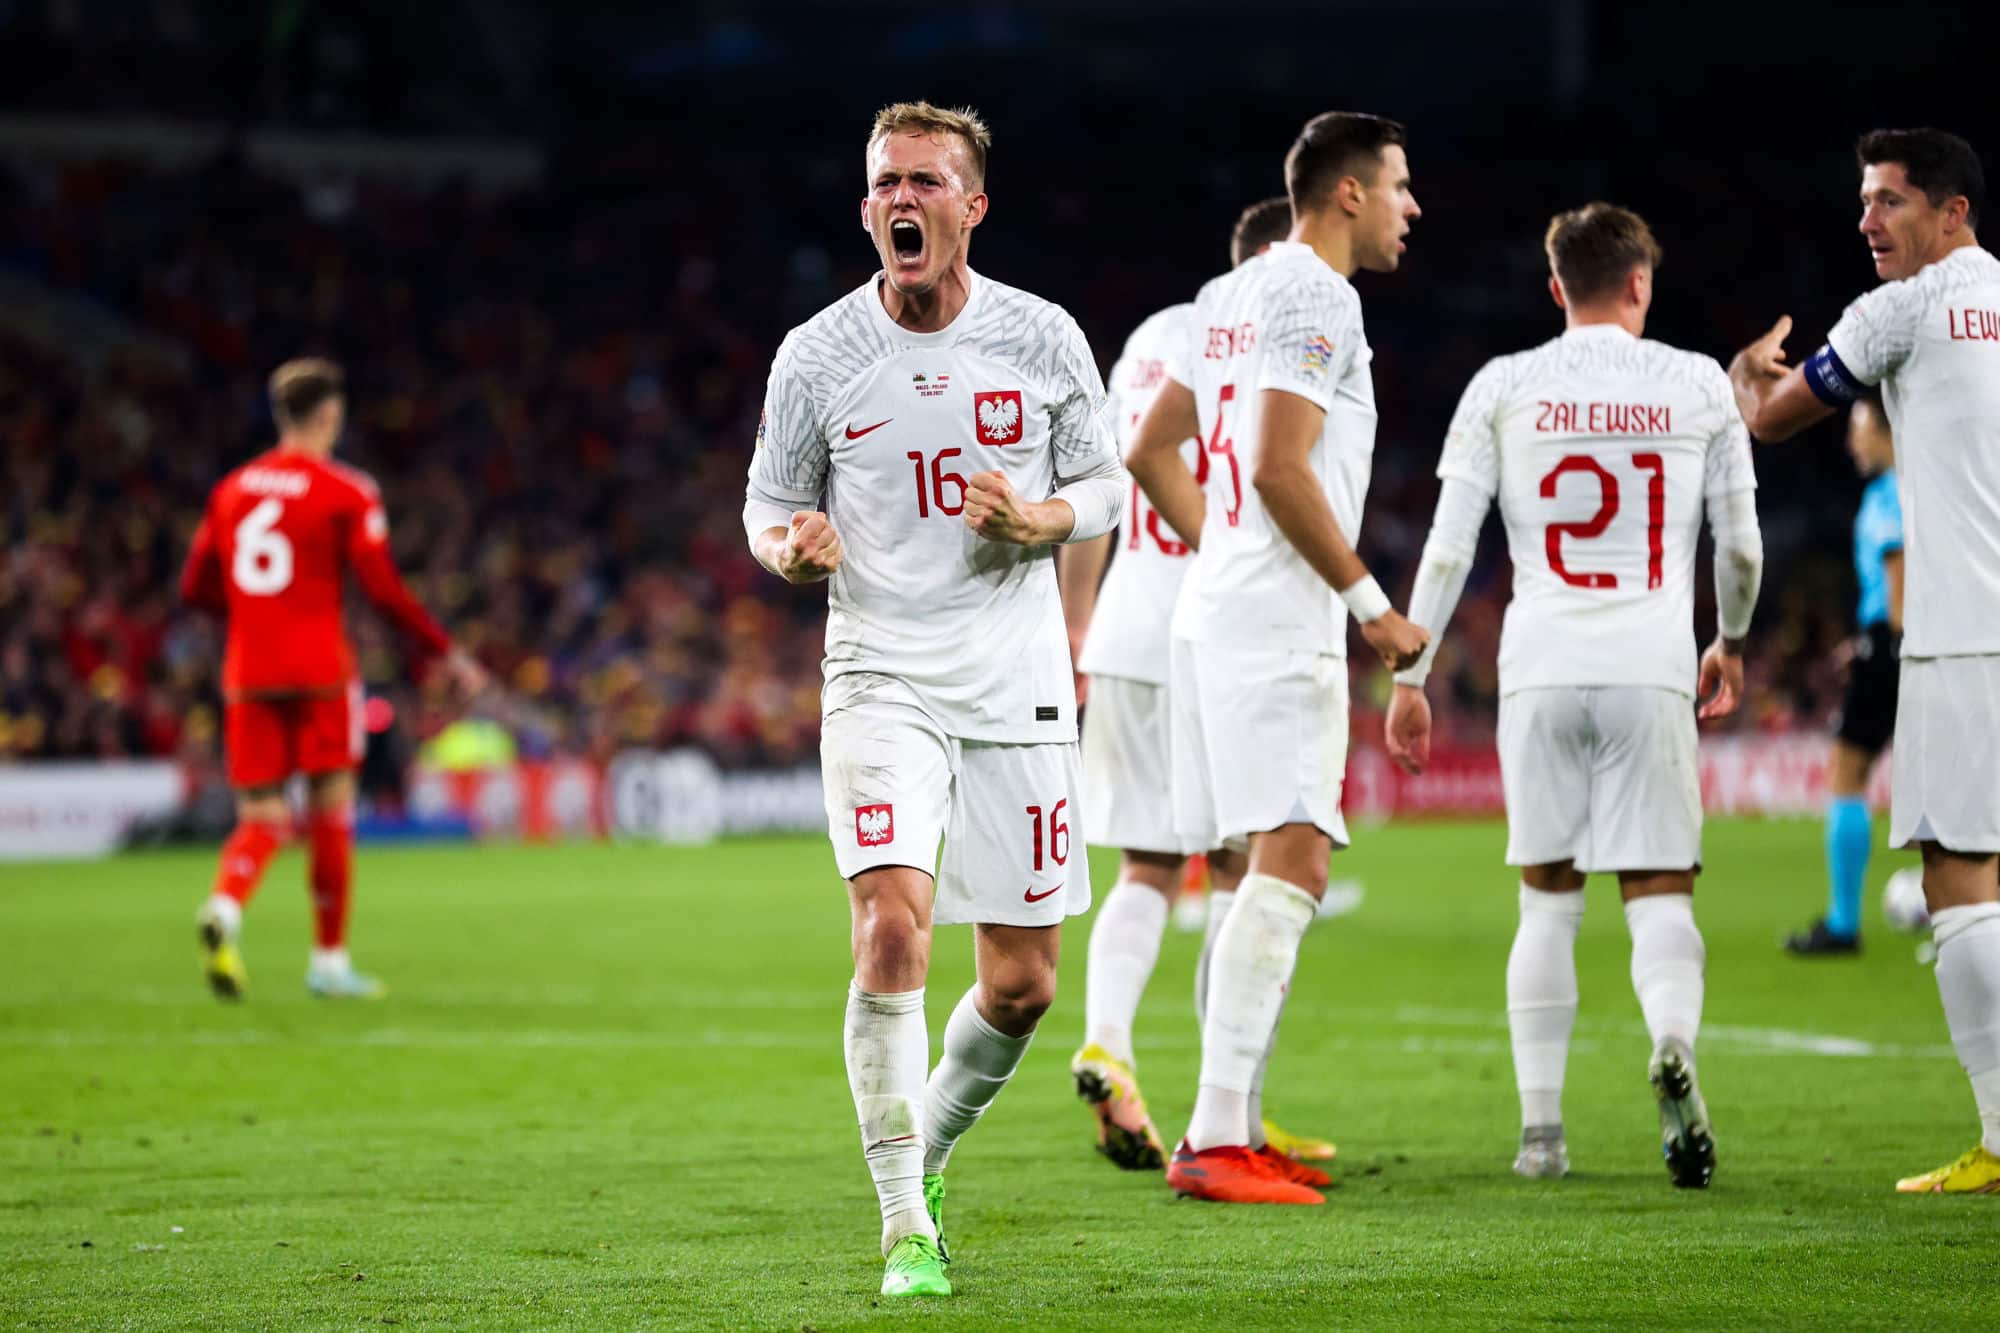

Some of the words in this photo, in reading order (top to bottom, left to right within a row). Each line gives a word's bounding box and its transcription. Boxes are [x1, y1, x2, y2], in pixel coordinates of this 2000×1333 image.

[1948, 308, 2000, 341] LEW
[1536, 400, 1671, 433] ZALEWSKI
[907, 447, 969, 518] 16
[232, 495, 294, 596] 6
[1539, 451, 1665, 592] 21
[1026, 797, 1069, 872] 16
